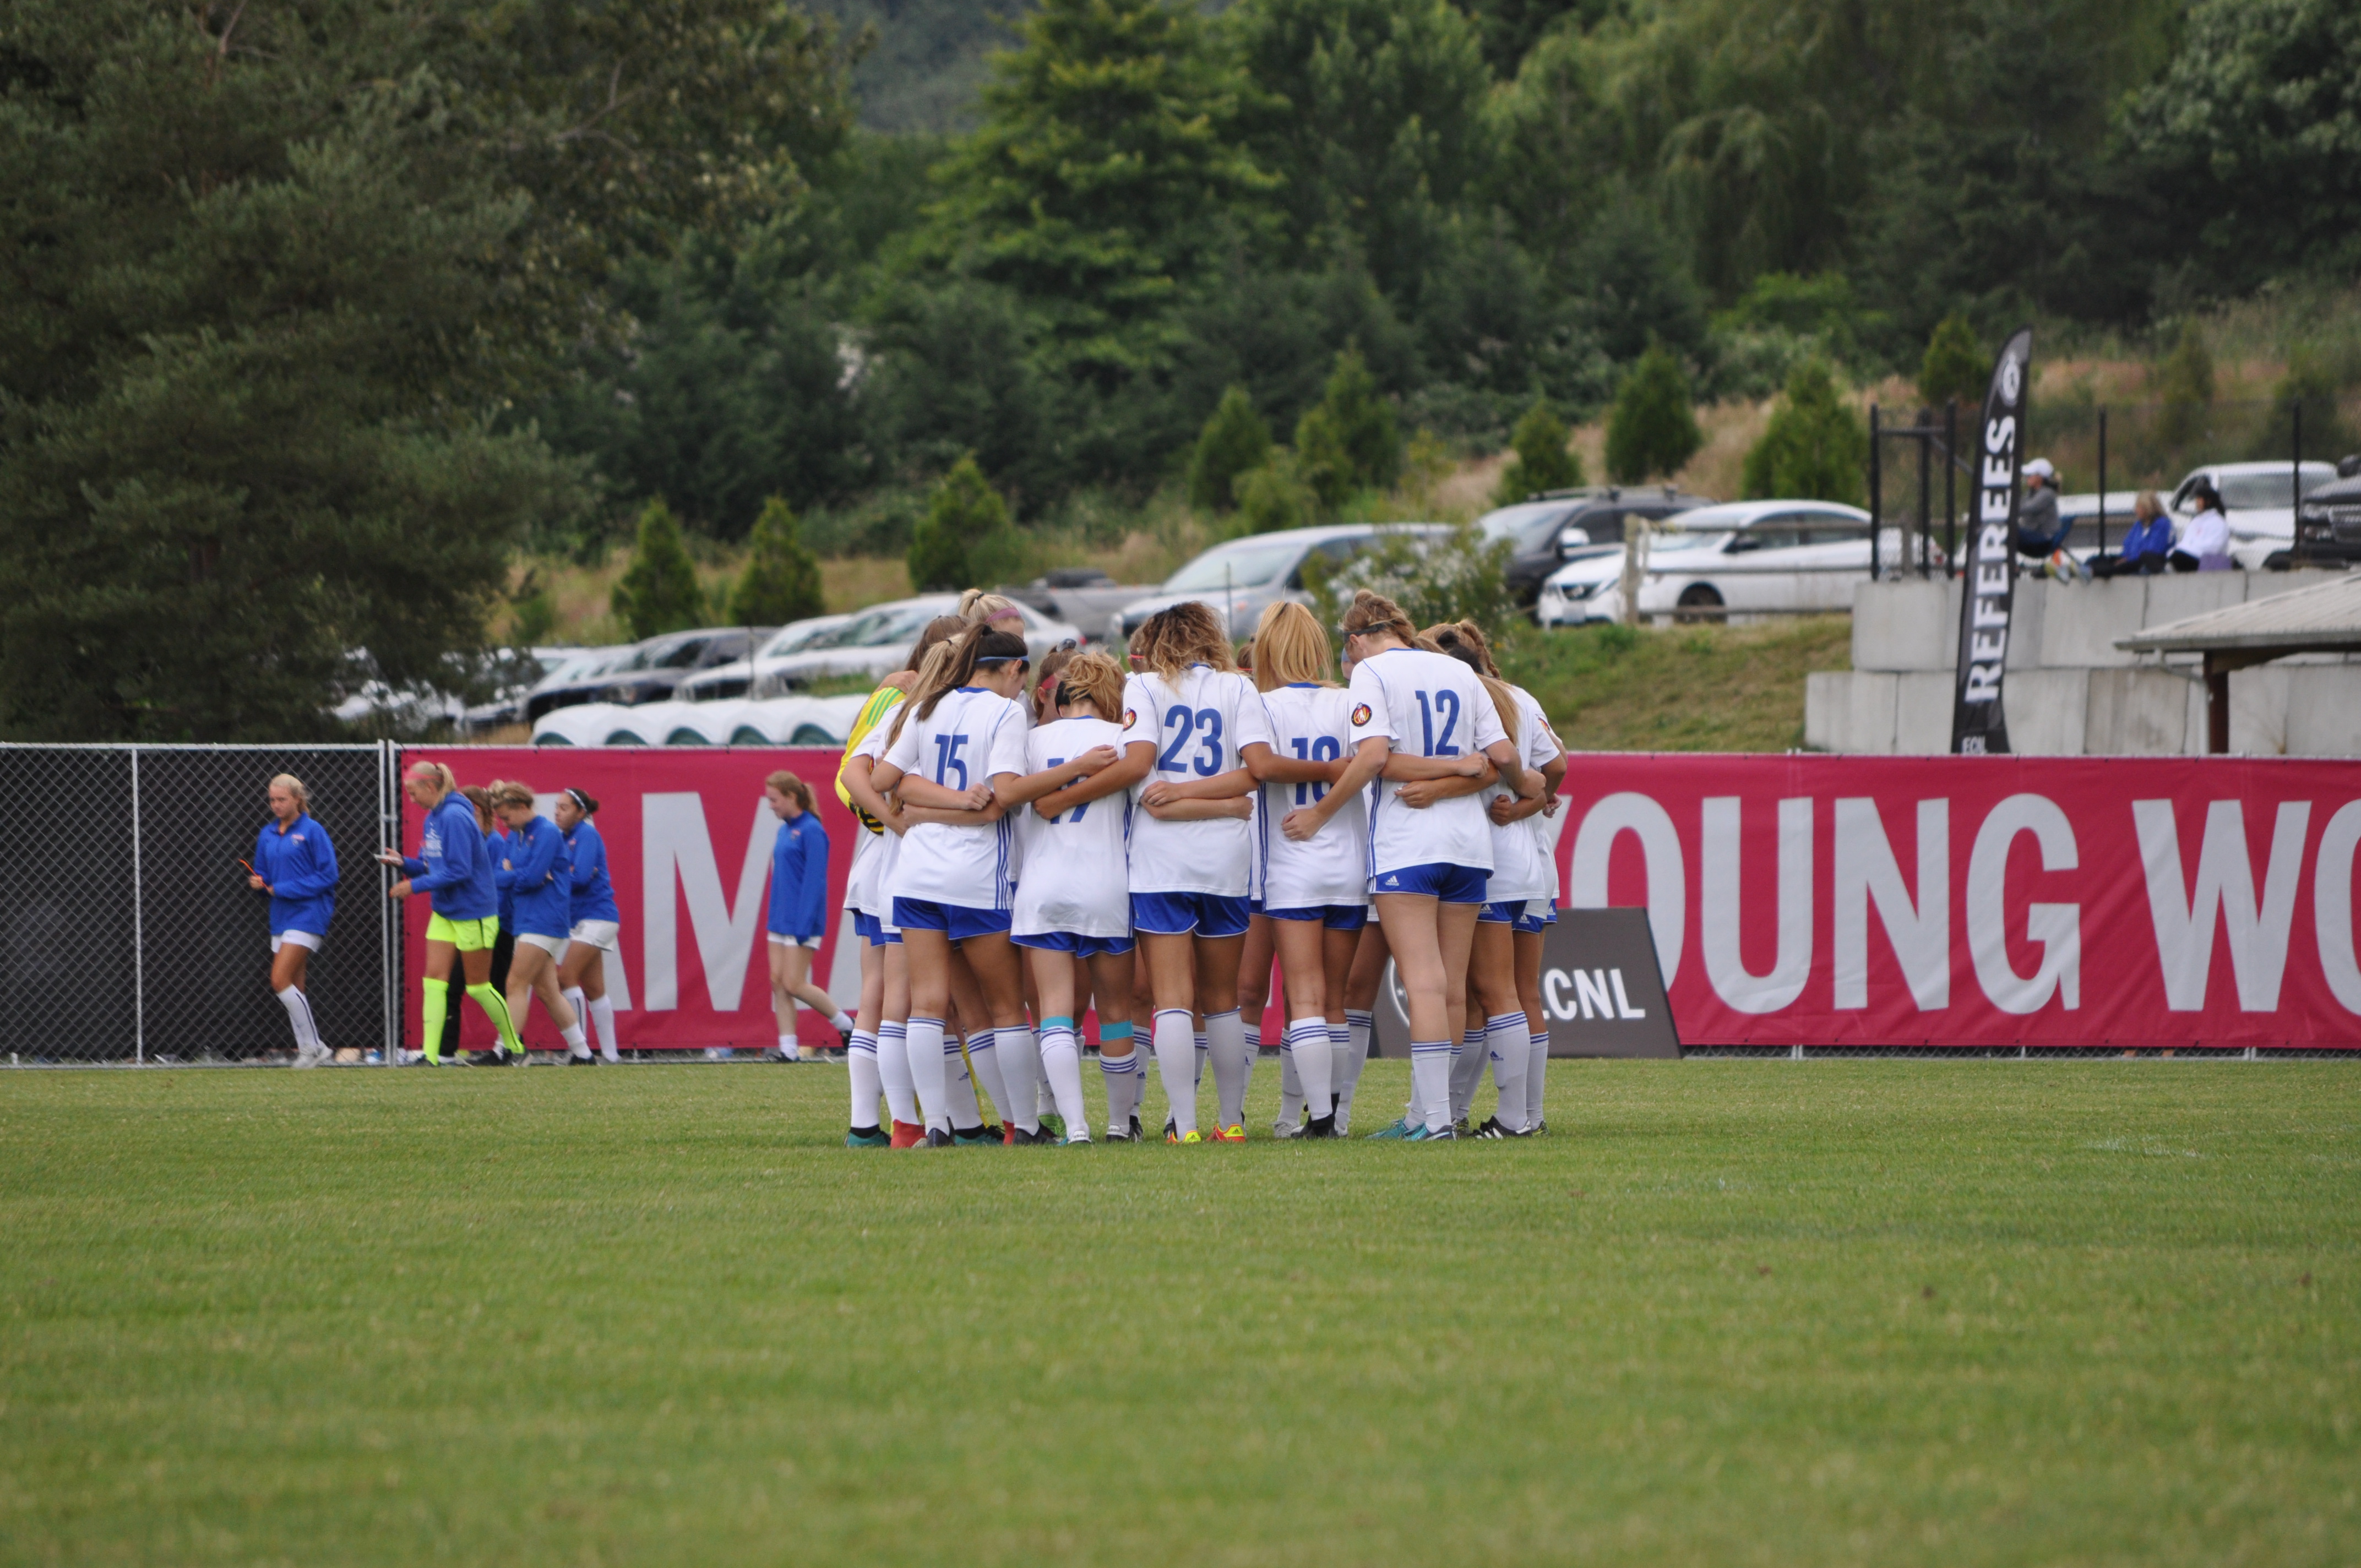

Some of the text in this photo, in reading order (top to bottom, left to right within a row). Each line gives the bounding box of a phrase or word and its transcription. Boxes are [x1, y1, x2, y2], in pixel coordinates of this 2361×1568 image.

[1964, 414, 2016, 703] REFEREES
[1157, 704, 1223, 777] 23
[1415, 689, 1460, 757] 12
[934, 734, 969, 791] 15
[1542, 967, 1646, 1022] CNL
